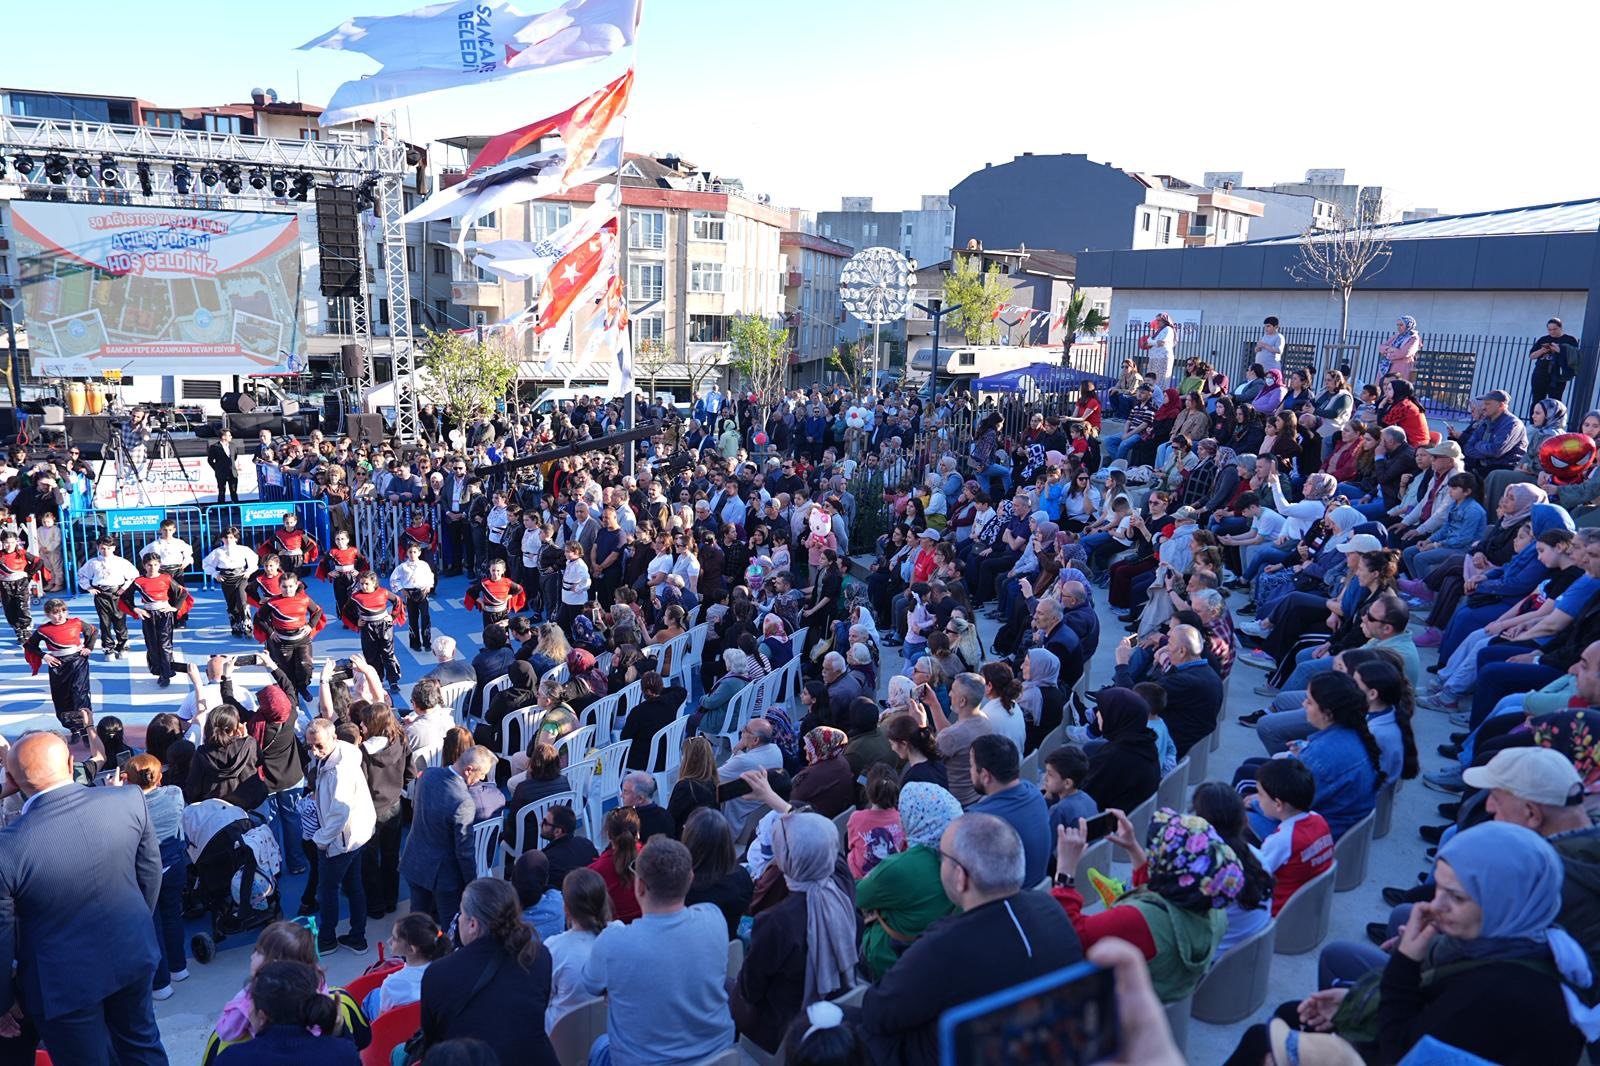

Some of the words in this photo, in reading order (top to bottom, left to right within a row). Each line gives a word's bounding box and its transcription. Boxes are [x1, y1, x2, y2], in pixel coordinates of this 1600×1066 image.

[89, 216, 104, 229] 30
[106, 212, 156, 229] AĞUSTOS
[156, 214, 193, 230] YAŞAM
[112, 231, 157, 251] AÇILIŞ
[158, 228, 211, 252] TÖRENİ
[107, 254, 143, 275] HOŞ
[144, 252, 217, 275] GELDİNİZ
